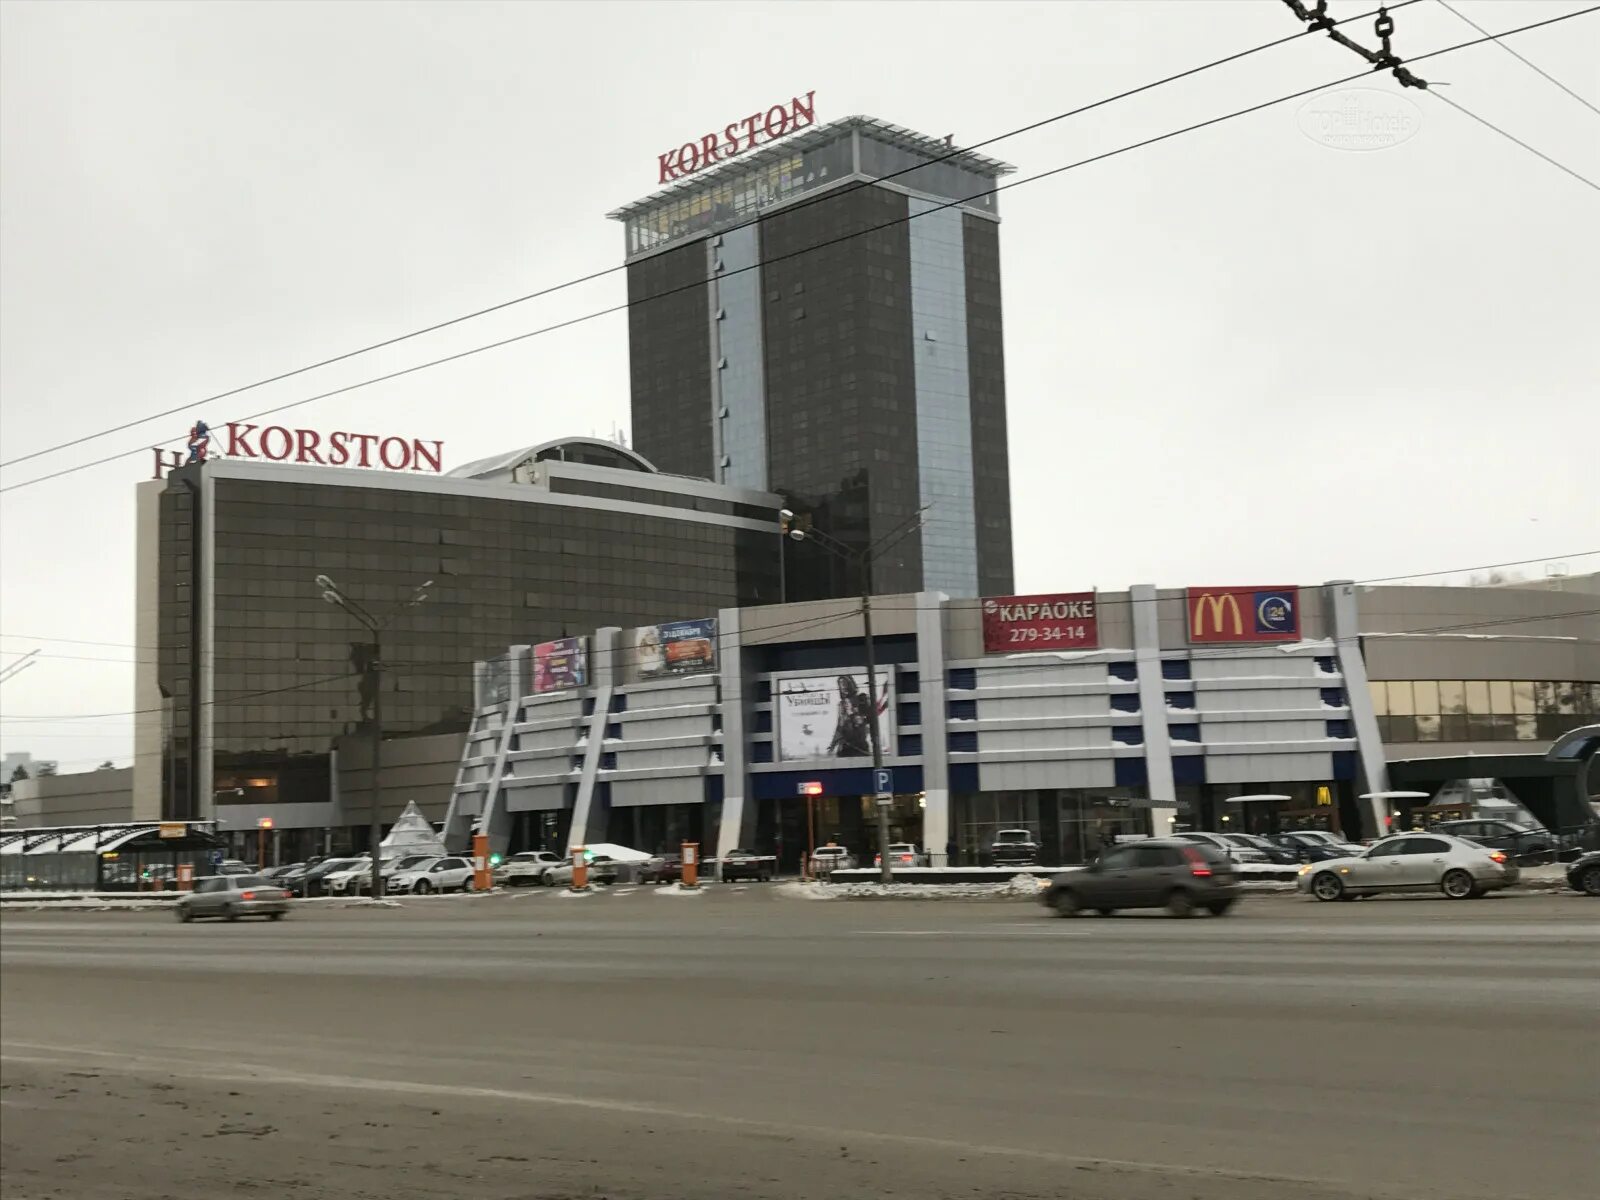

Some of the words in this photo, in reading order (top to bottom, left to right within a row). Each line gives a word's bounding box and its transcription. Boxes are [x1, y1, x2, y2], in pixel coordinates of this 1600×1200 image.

[658, 90, 816, 184] KORSTON
[226, 422, 444, 473] KORSTON
[1000, 600, 1093, 622] КАРАОКЕ
[1009, 626, 1086, 642] 279-34-14
[878, 772, 889, 790] P
